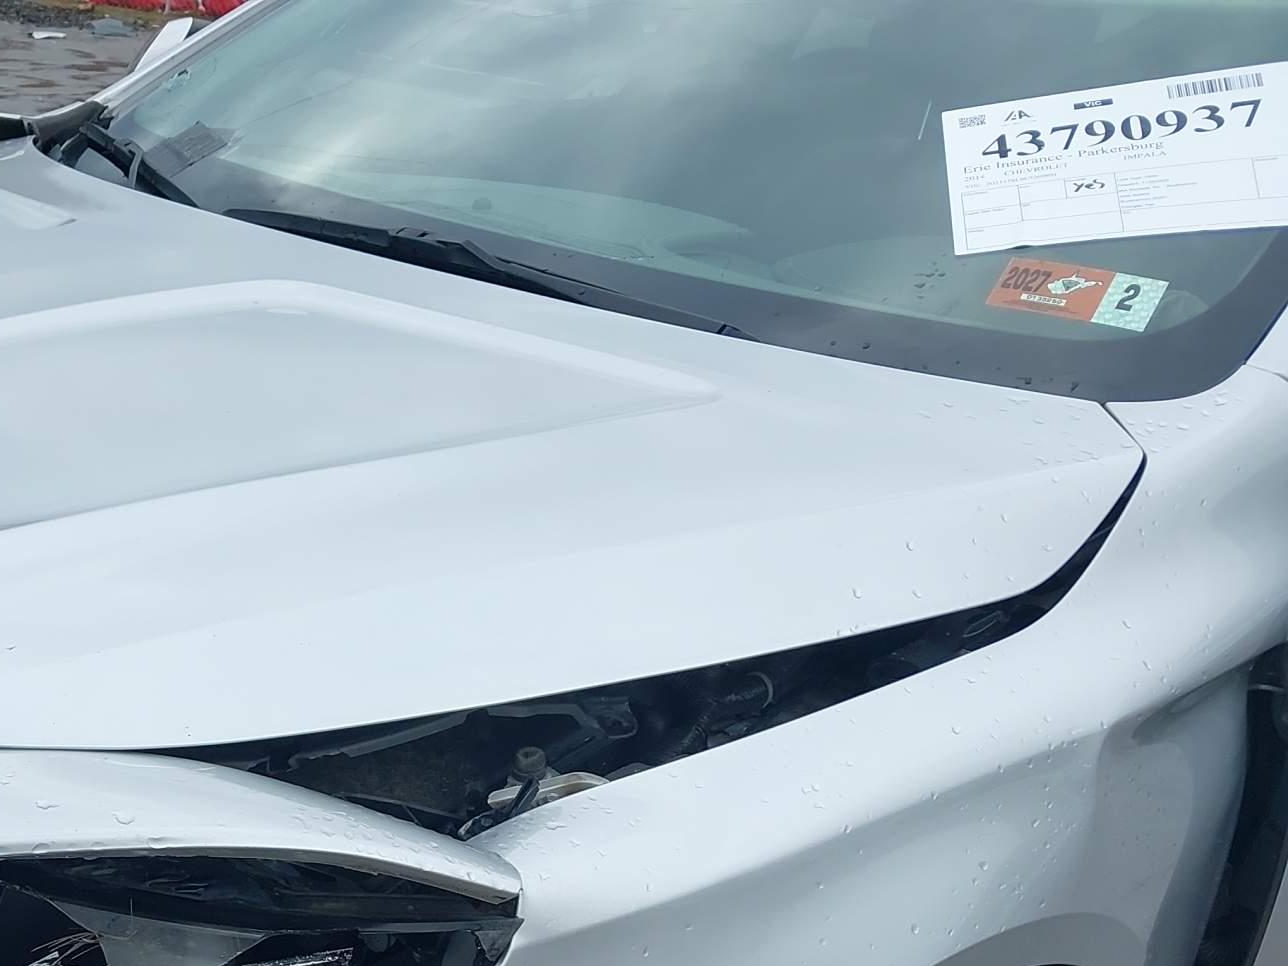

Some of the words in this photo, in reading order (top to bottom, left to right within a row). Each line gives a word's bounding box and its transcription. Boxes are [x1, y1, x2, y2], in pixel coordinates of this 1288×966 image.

[981, 98, 1263, 159] 43790937
[963, 164, 992, 174] Erie
[996, 154, 1063, 169] Insurance
[1078, 141, 1164, 158] Parkersburg
[1123, 150, 1167, 161] IMPALA
[1000, 265, 1053, 294] 2027
[1114, 283, 1142, 312] 2
